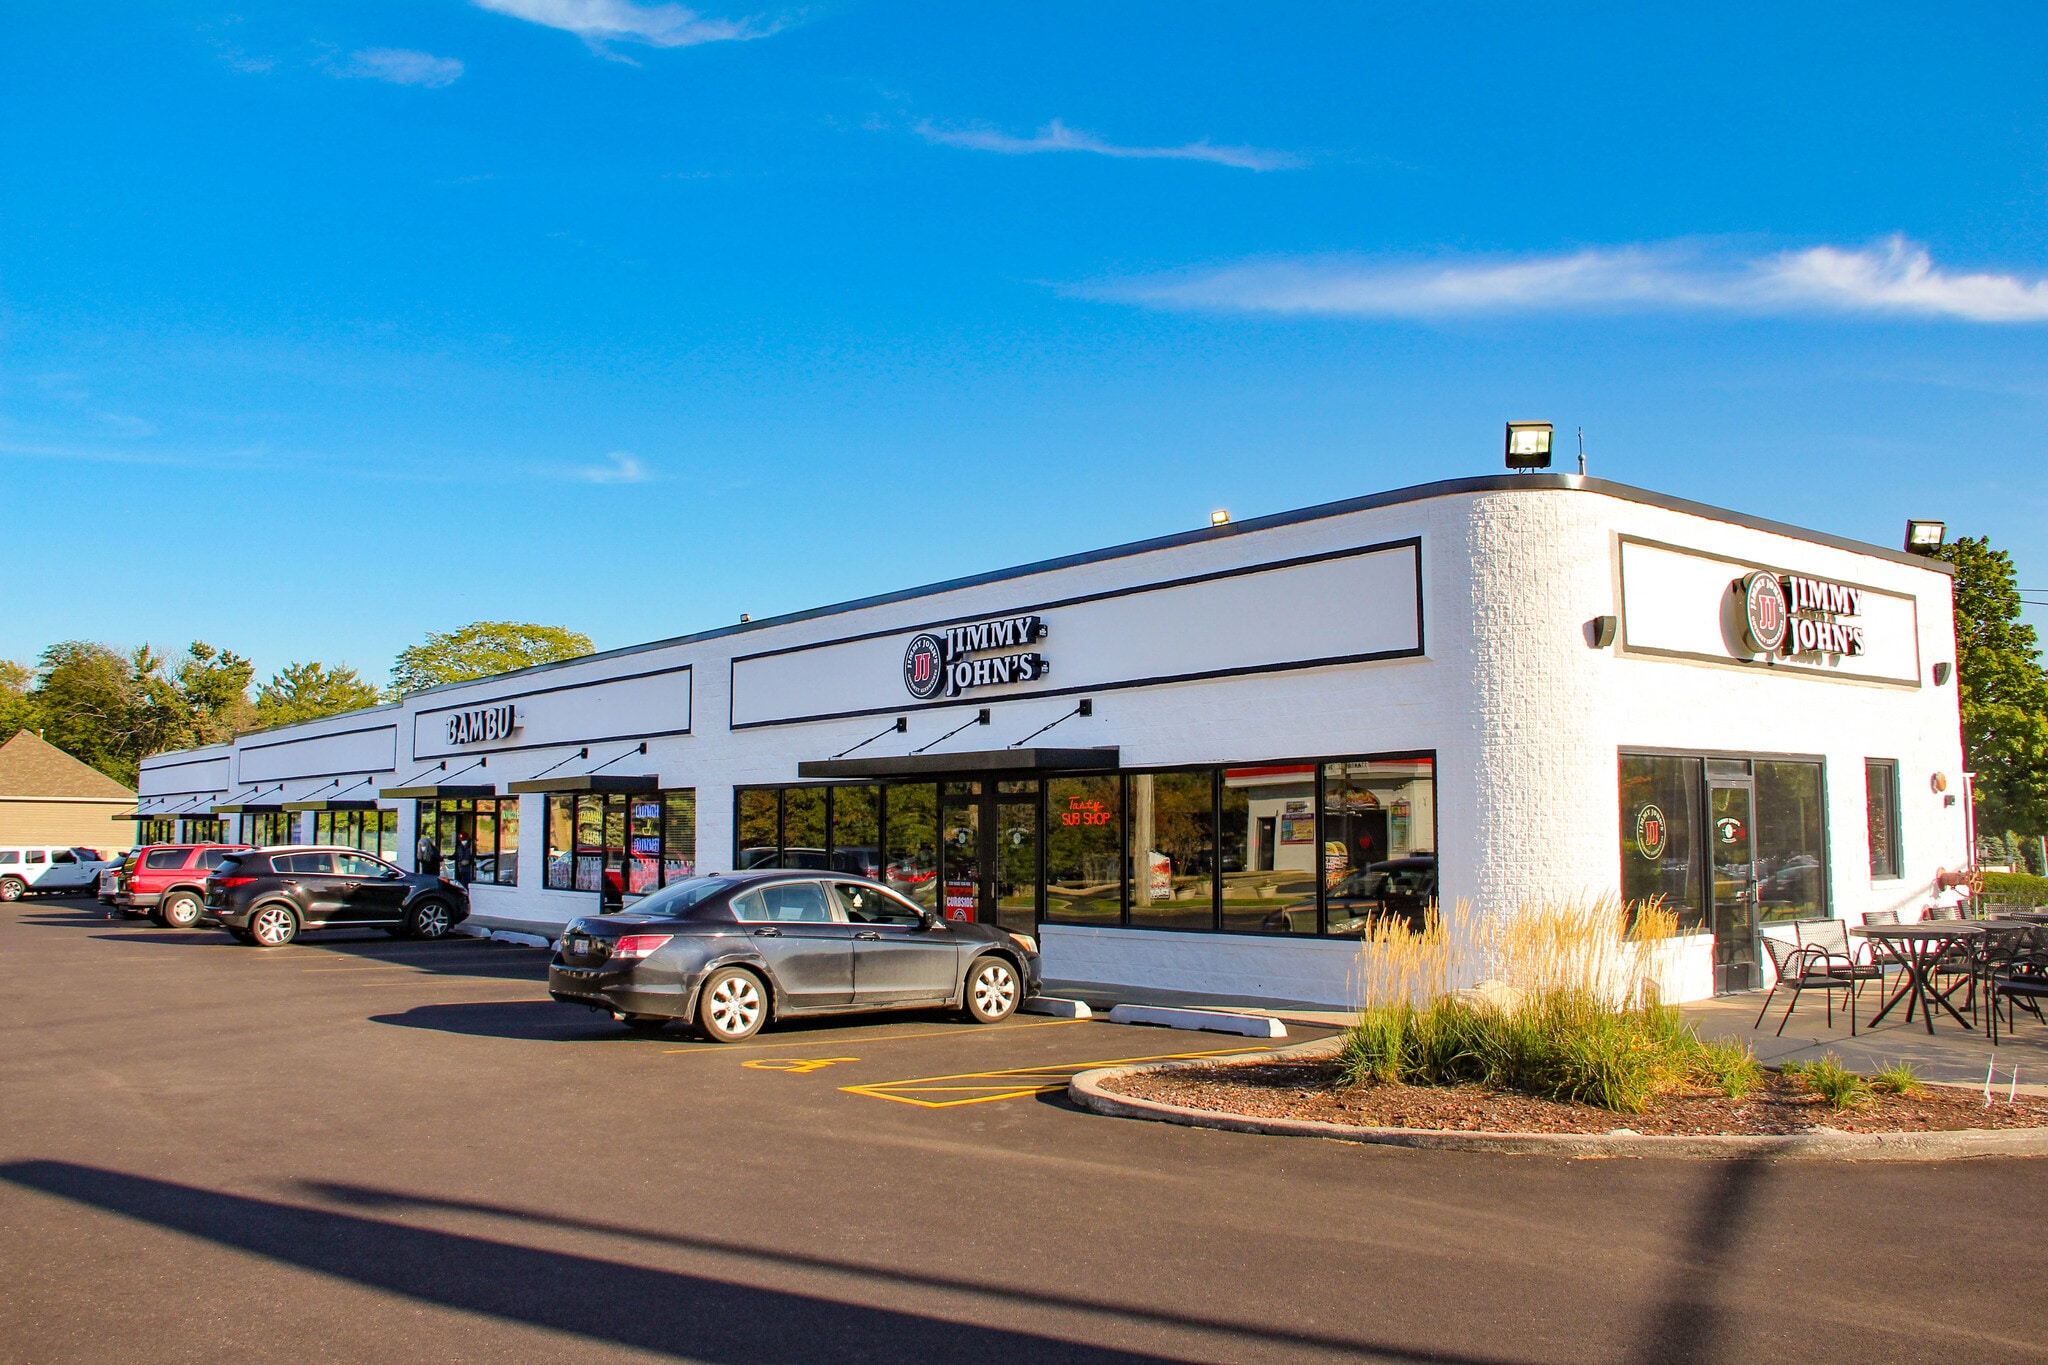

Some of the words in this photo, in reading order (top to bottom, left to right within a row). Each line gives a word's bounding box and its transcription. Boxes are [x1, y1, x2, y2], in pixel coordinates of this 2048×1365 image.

[1758, 594, 1776, 630] JJ
[1788, 575, 1862, 615] JIMMY
[946, 616, 1032, 660] JIMMY
[1789, 617, 1865, 656] JOHN'S
[914, 653, 930, 682] JJ
[946, 653, 1033, 697] JOHN'S
[447, 704, 513, 745] BAMBU
[1061, 812, 1080, 826] SUB
[1083, 812, 1110, 826] SHOP
[1069, 795, 1104, 812] Tasty
[1645, 820, 1659, 847] JJ
